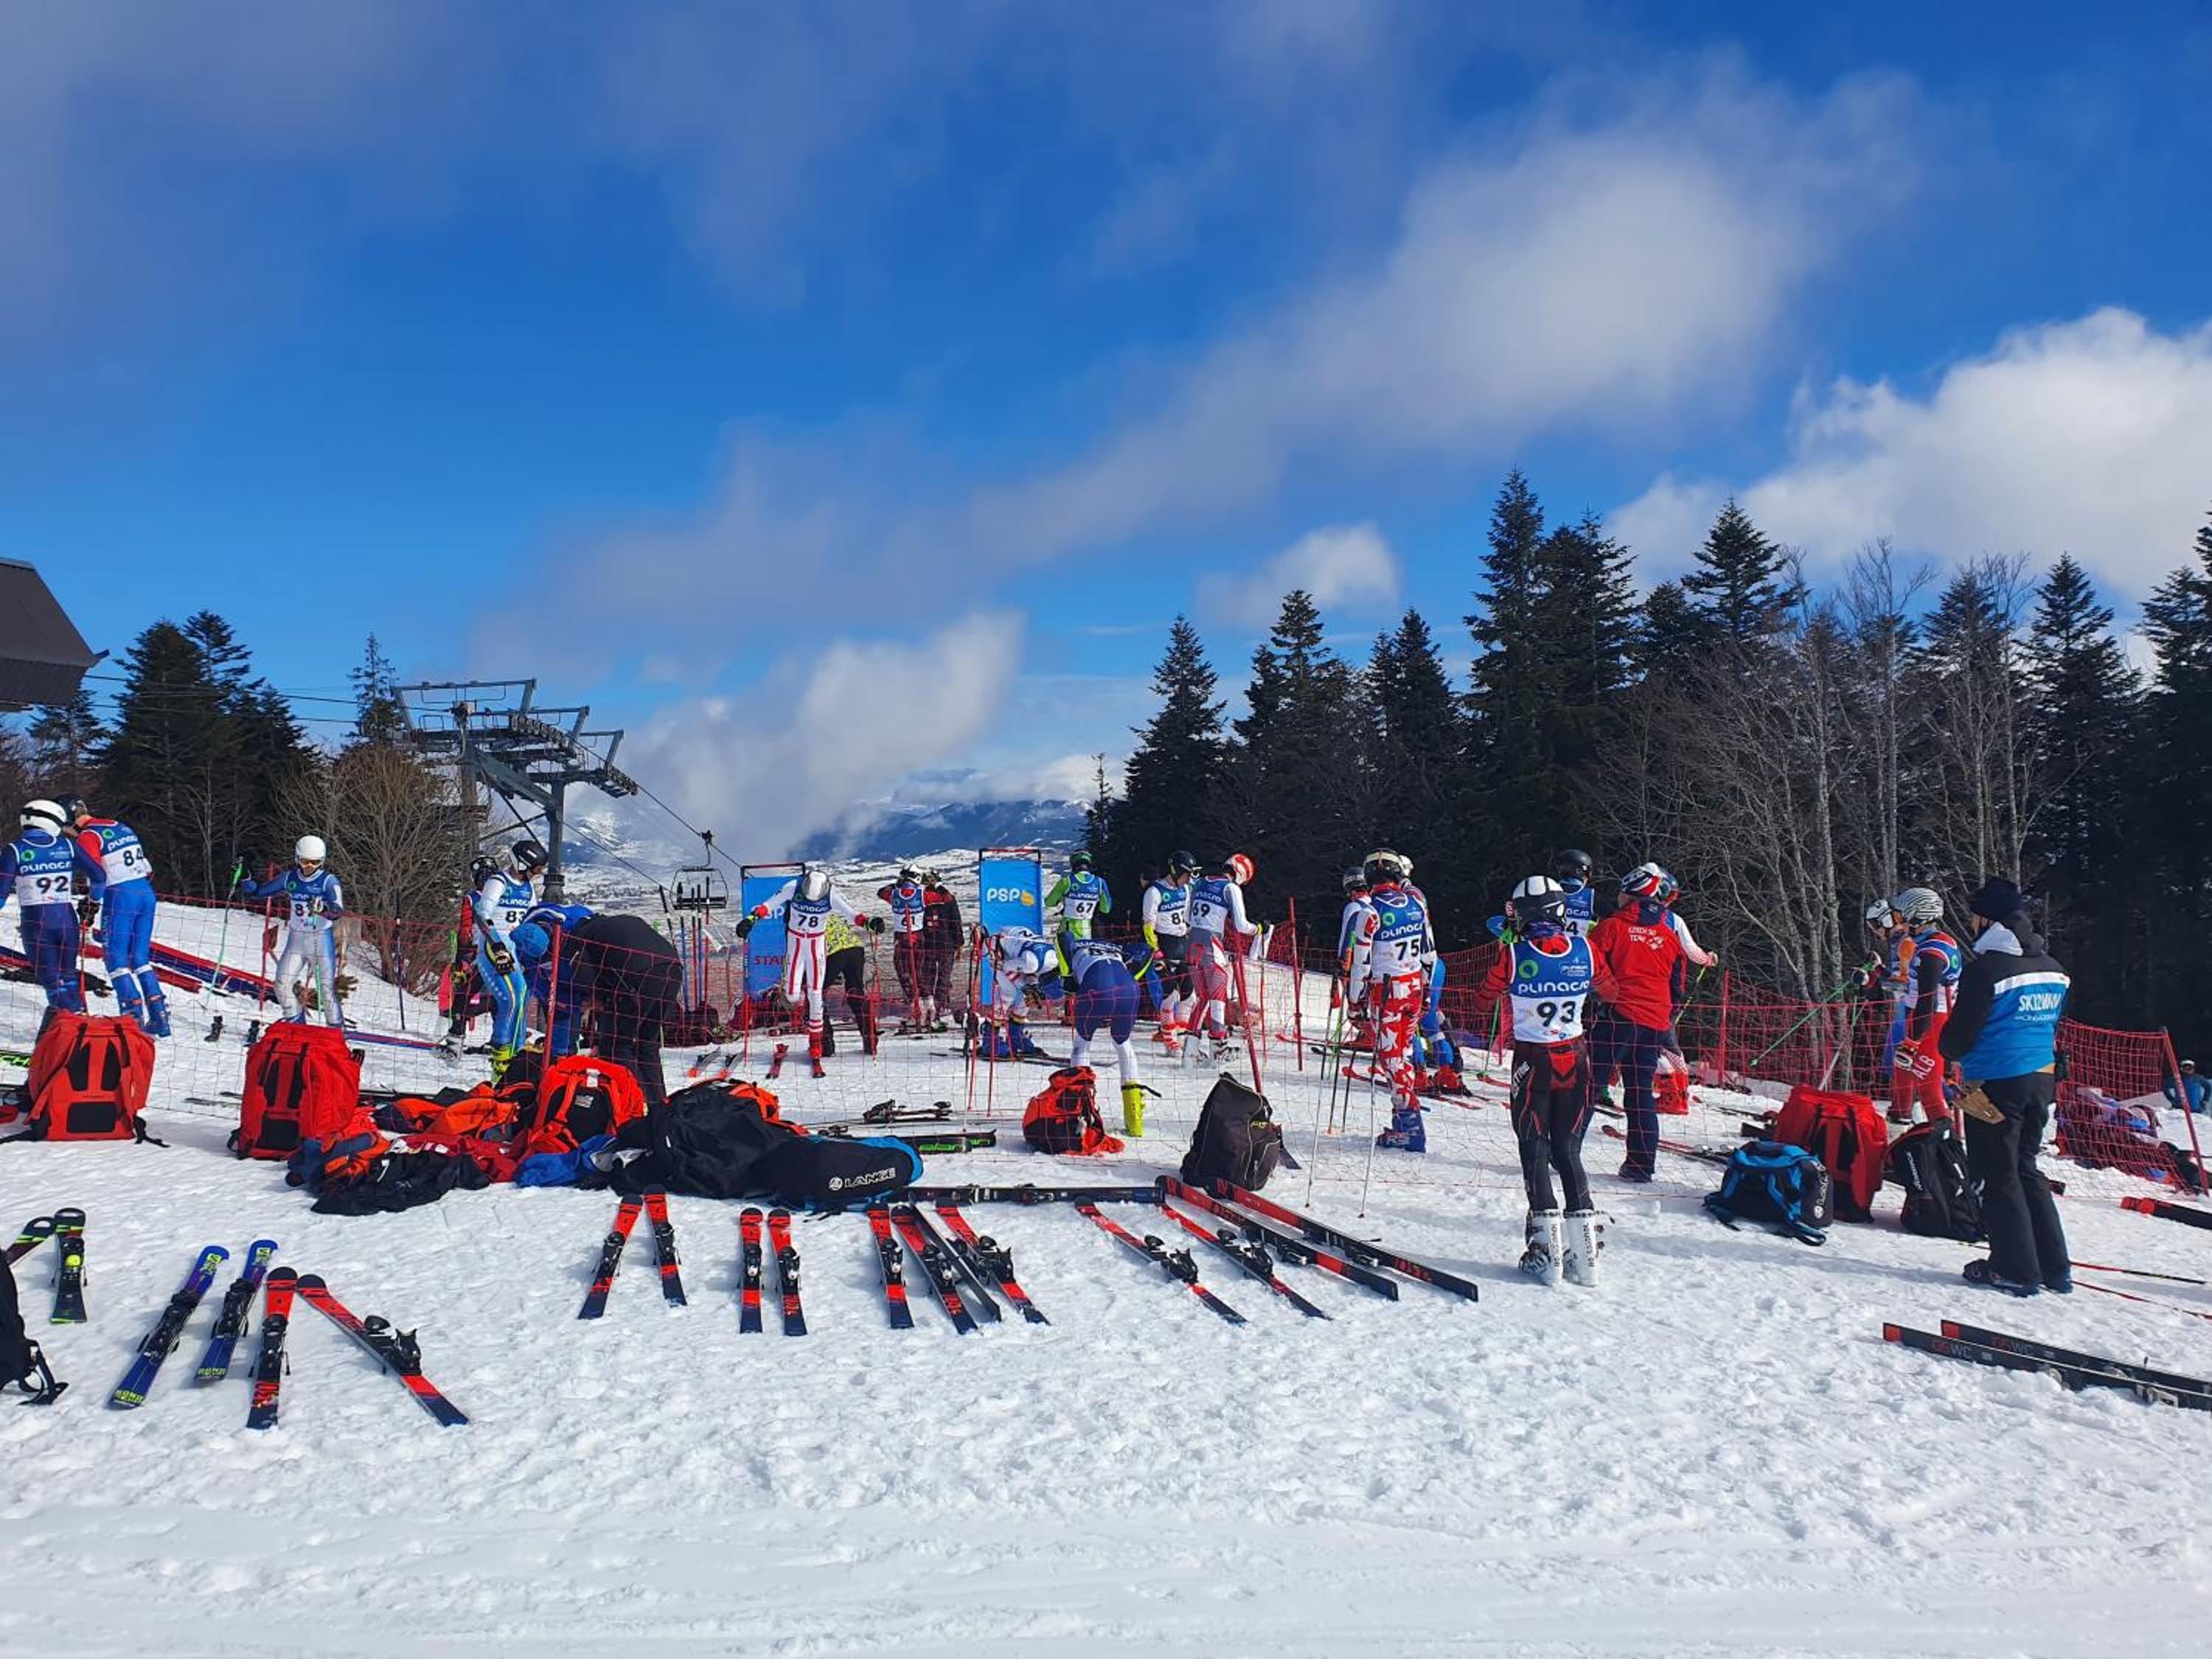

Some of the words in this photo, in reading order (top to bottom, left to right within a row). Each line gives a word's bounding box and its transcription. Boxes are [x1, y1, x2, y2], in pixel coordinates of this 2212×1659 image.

[123, 849, 143, 866] 84
[37, 875, 69, 894] 92
[987, 888, 1020, 902] PSP
[1076, 902, 1093, 914] 67
[1192, 902, 1211, 917] 69
[798, 914, 818, 928] 78
[1565, 920, 1579, 936] 4
[1395, 938, 1420, 961] 75
[1537, 1001, 1576, 1027] 93
[1912, 1055, 1935, 1080] ALB
[844, 1168, 897, 1189] LANGE
